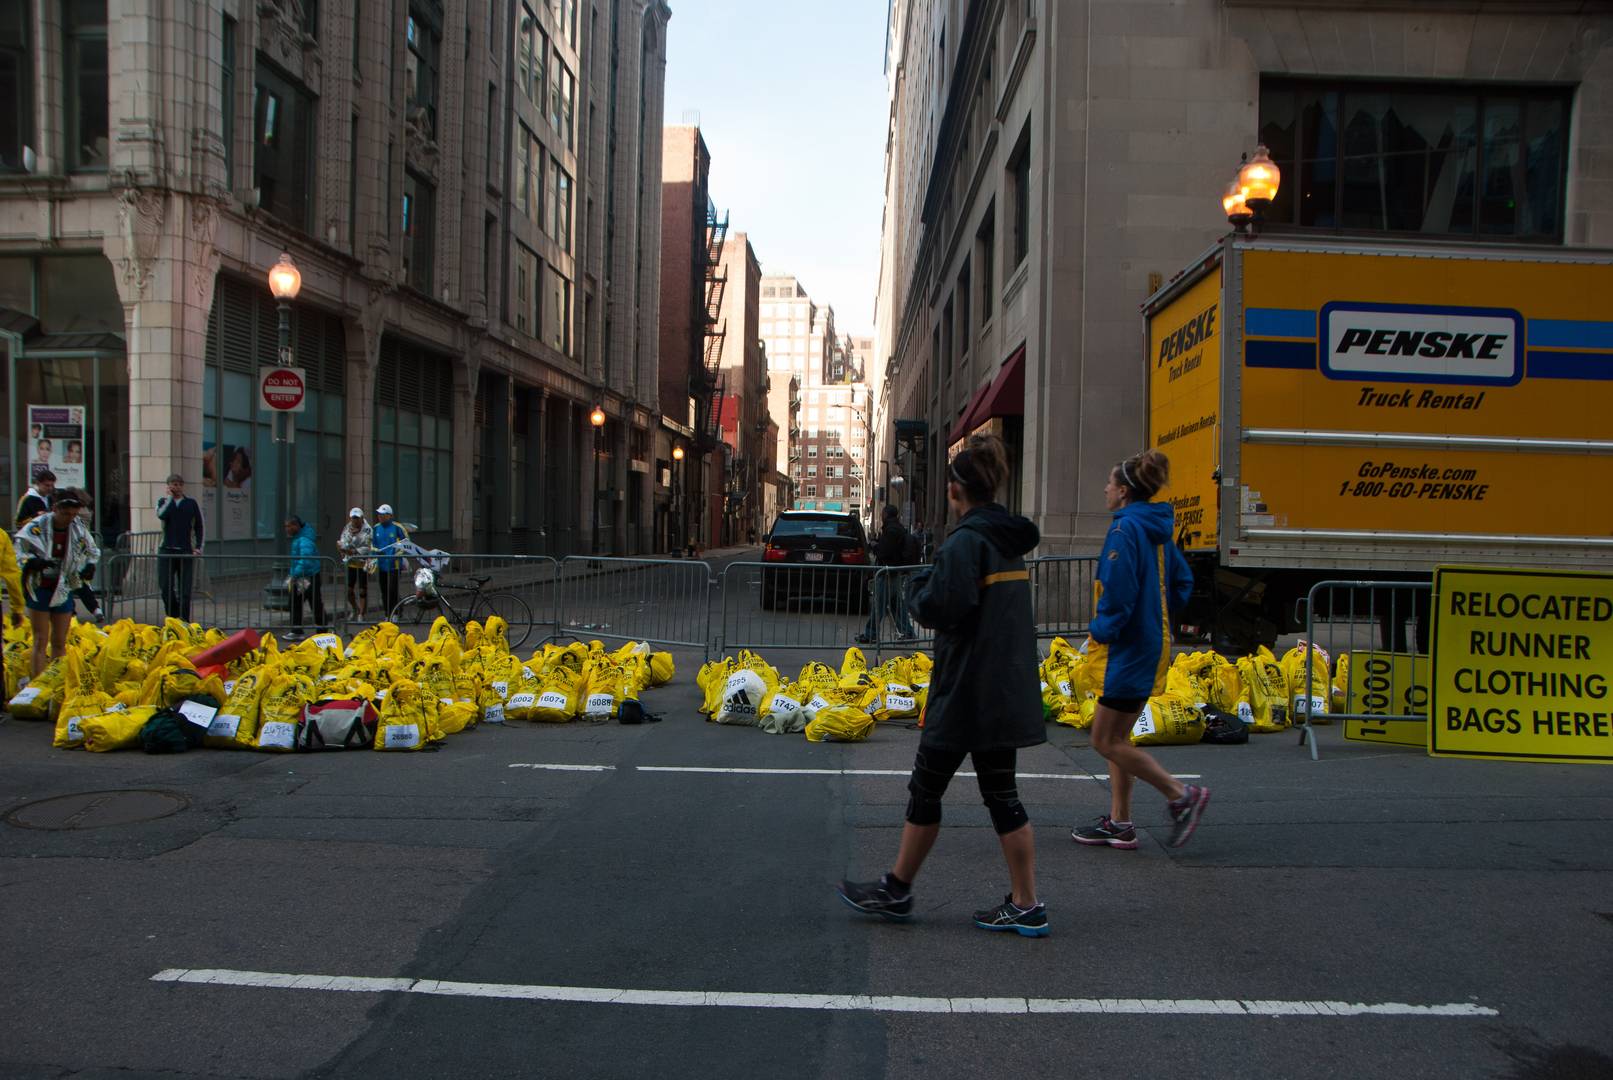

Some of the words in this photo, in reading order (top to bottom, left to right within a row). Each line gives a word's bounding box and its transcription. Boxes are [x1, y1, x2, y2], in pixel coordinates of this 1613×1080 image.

[1158, 304, 1217, 368] PENSKE
[1335, 328, 1509, 360] PENSKE
[283, 378, 299, 386] NOT
[271, 394, 296, 402] ENTER
[1357, 387, 1412, 408] Truck
[1416, 389, 1485, 411] Rental
[1358, 462, 1477, 481] GoPenske.com
[1339, 481, 1490, 502] 1-800-GO-PENSKE
[1450, 591, 1613, 621] RELOCATED
[1470, 631, 1592, 660] RUNNER
[1454, 668, 1608, 699] CLOTHING
[541, 696, 565, 704] 16074
[723, 703, 756, 714] adidas
[1447, 707, 1521, 734] BAGS
